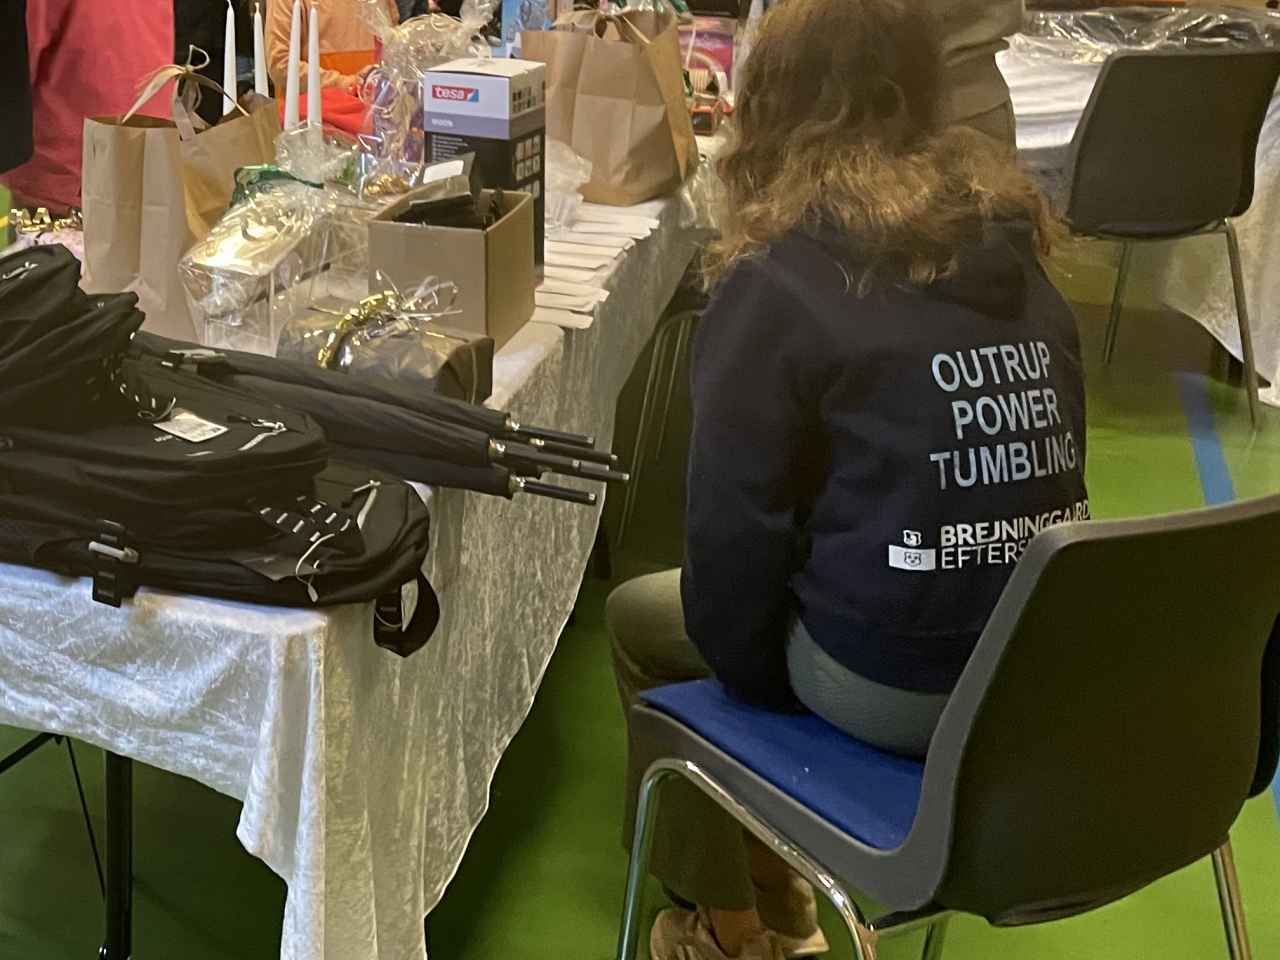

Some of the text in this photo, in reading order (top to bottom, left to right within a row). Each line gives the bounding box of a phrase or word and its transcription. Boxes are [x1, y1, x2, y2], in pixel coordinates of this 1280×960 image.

[931, 341, 1051, 392] OUTRUP
[951, 388, 1062, 440] POWER
[929, 431, 1077, 490] TUMBLING
[941, 540, 1031, 569] EFTERS
